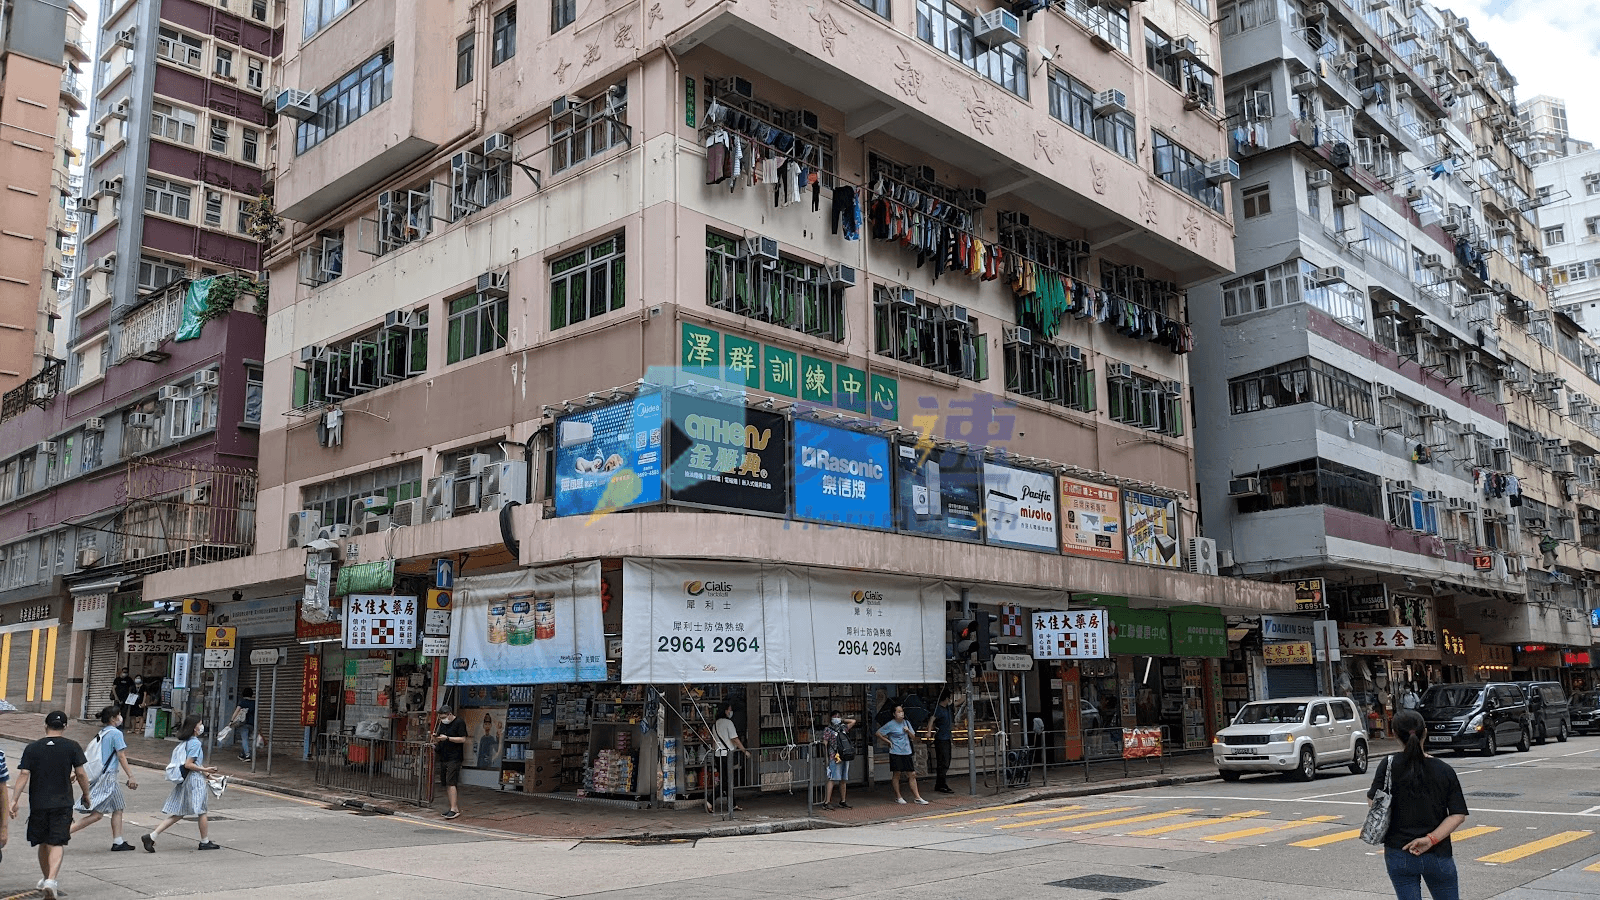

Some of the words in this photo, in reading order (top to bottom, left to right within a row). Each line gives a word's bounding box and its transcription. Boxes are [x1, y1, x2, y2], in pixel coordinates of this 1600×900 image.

[687, 332, 894, 412] 澤群訓練中心
[637, 403, 660, 416] Midea
[816, 448, 884, 481] Rasonic
[822, 475, 866, 500] 樂信牌
[1021, 484, 1051, 504] Pacific
[1020, 505, 1052, 522] misoko
[1474, 556, 1491, 568] 12
[704, 581, 732, 592] Cialis
[864, 590, 883, 601] Cialis
[351, 598, 415, 616] 永佳大藥房
[686, 599, 731, 610] 犀利士
[854, 606, 883, 617] 犀利士
[673, 620, 745, 632] 犀利士防偽熱線
[1034, 612, 1100, 630] 永佳大藥房
[1271, 623, 1297, 635] DAIKIN
[658, 636, 706, 653] 2964
[712, 636, 760, 653] 2964
[838, 640, 869, 656] 2964
[872, 641, 902, 656] 2964
[307, 656, 318, 725] 時代地產
